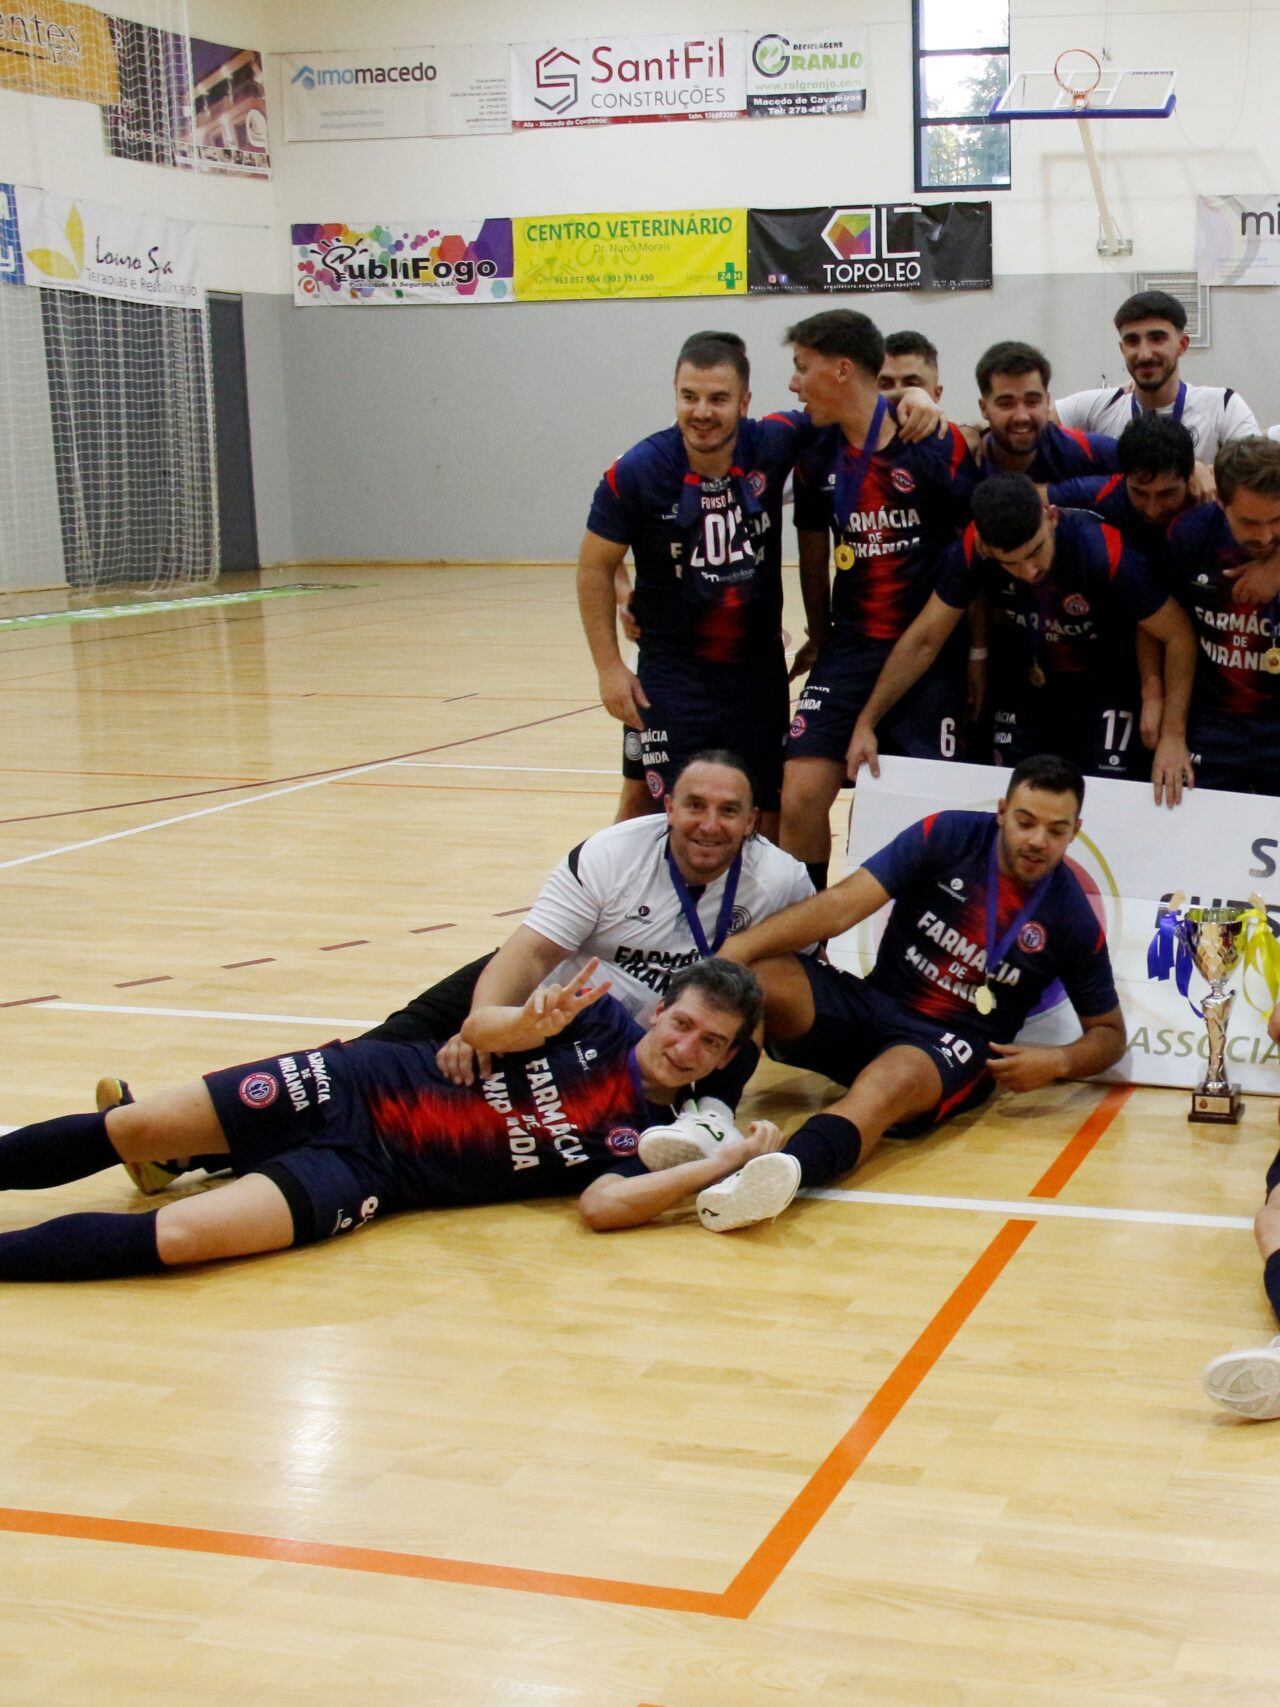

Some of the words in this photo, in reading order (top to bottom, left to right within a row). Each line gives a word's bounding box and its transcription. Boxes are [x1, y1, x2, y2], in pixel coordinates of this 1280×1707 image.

[0, 13, 81, 53] ntes
[317, 62, 437, 86] imomacedo
[591, 37, 725, 84] SantFil
[591, 84, 727, 110] CONSTRUÇÕES
[753, 97, 793, 106] Macedo
[795, 96, 808, 105] de
[810, 94, 862, 104] Cavaleiros
[526, 221, 601, 242] CENTRO
[607, 213, 732, 239] VETERINÁRIO
[823, 261, 921, 284] TOPOLEO
[1232, 634, 1249, 648] DE
[940, 716, 956, 758] 6
[1102, 709, 1134, 752] 17
[948, 961, 968, 980] DE
[277, 1056, 311, 1112] MIRANDA
[306, 1051, 331, 1105] ARMÁCIA
[525, 1057, 590, 1167] FARMÁCIA
